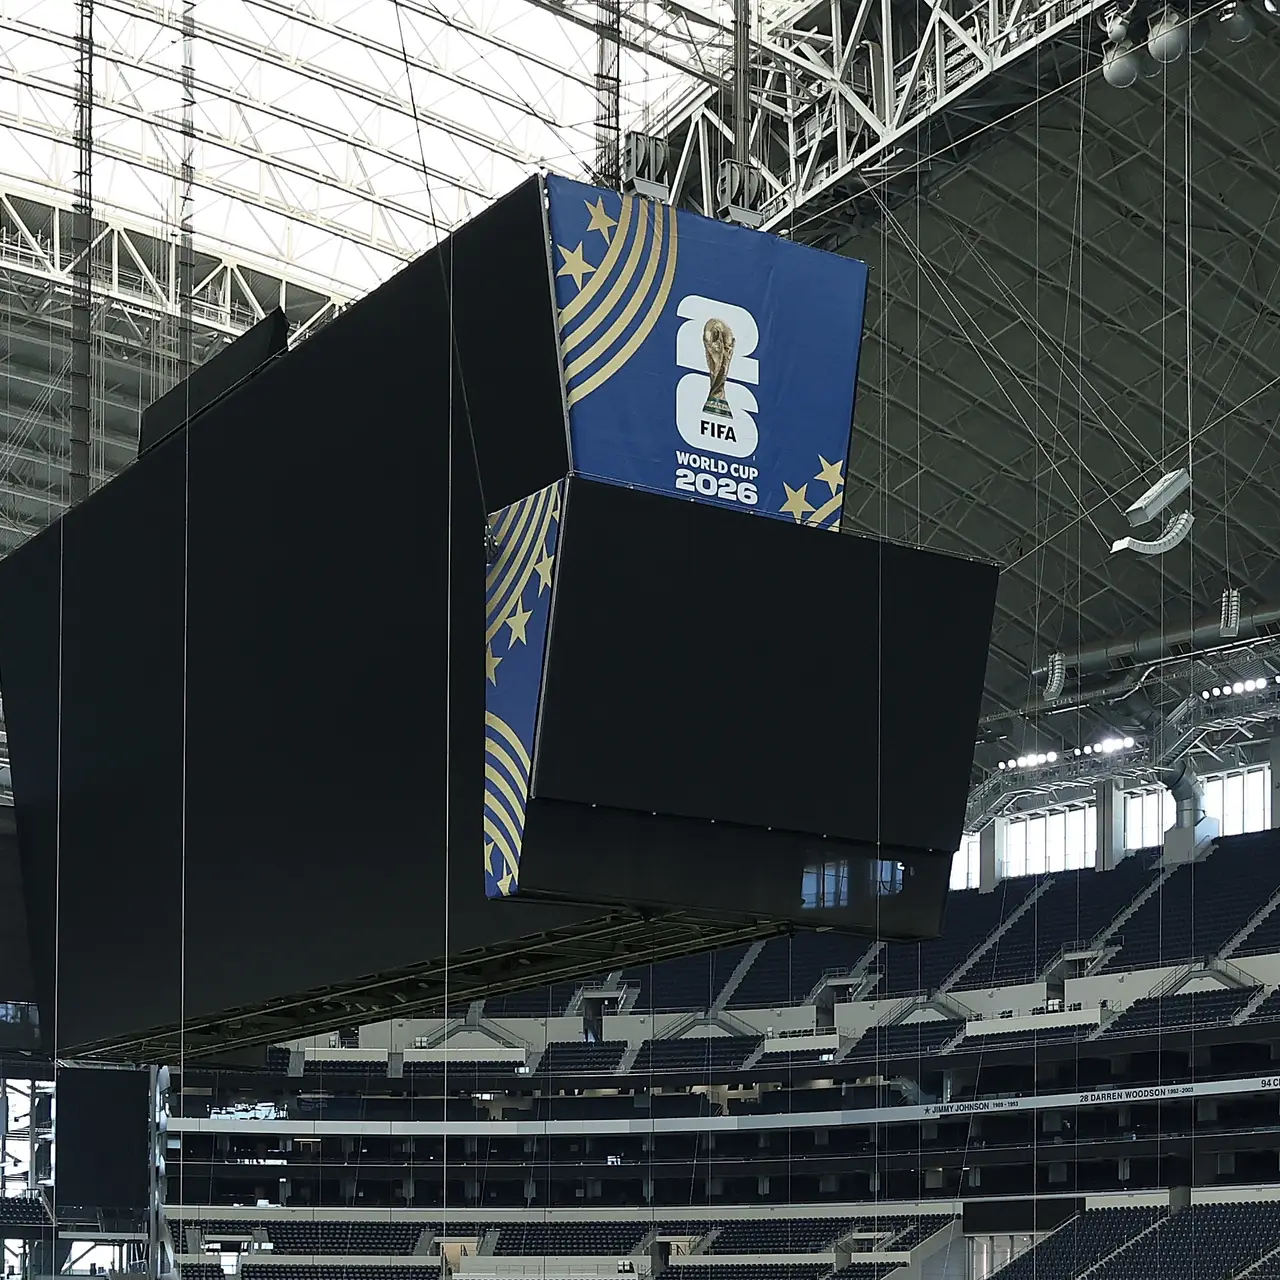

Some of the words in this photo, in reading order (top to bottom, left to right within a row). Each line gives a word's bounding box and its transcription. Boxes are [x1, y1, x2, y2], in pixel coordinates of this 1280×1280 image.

[700, 420, 737, 443] FIFA
[675, 450, 728, 474] WORLD
[729, 463, 759, 481] CUP
[675, 468, 759, 505] 2026
[1261, 1079, 1272, 1088] 94
[1079, 1094, 1089, 1103] 28
[1090, 1091, 1123, 1102] DARREN
[1124, 1088, 1166, 1100] WOODSON
[931, 1105, 955, 1114] JIMMY
[955, 1102, 990, 1113] JOHNSON
